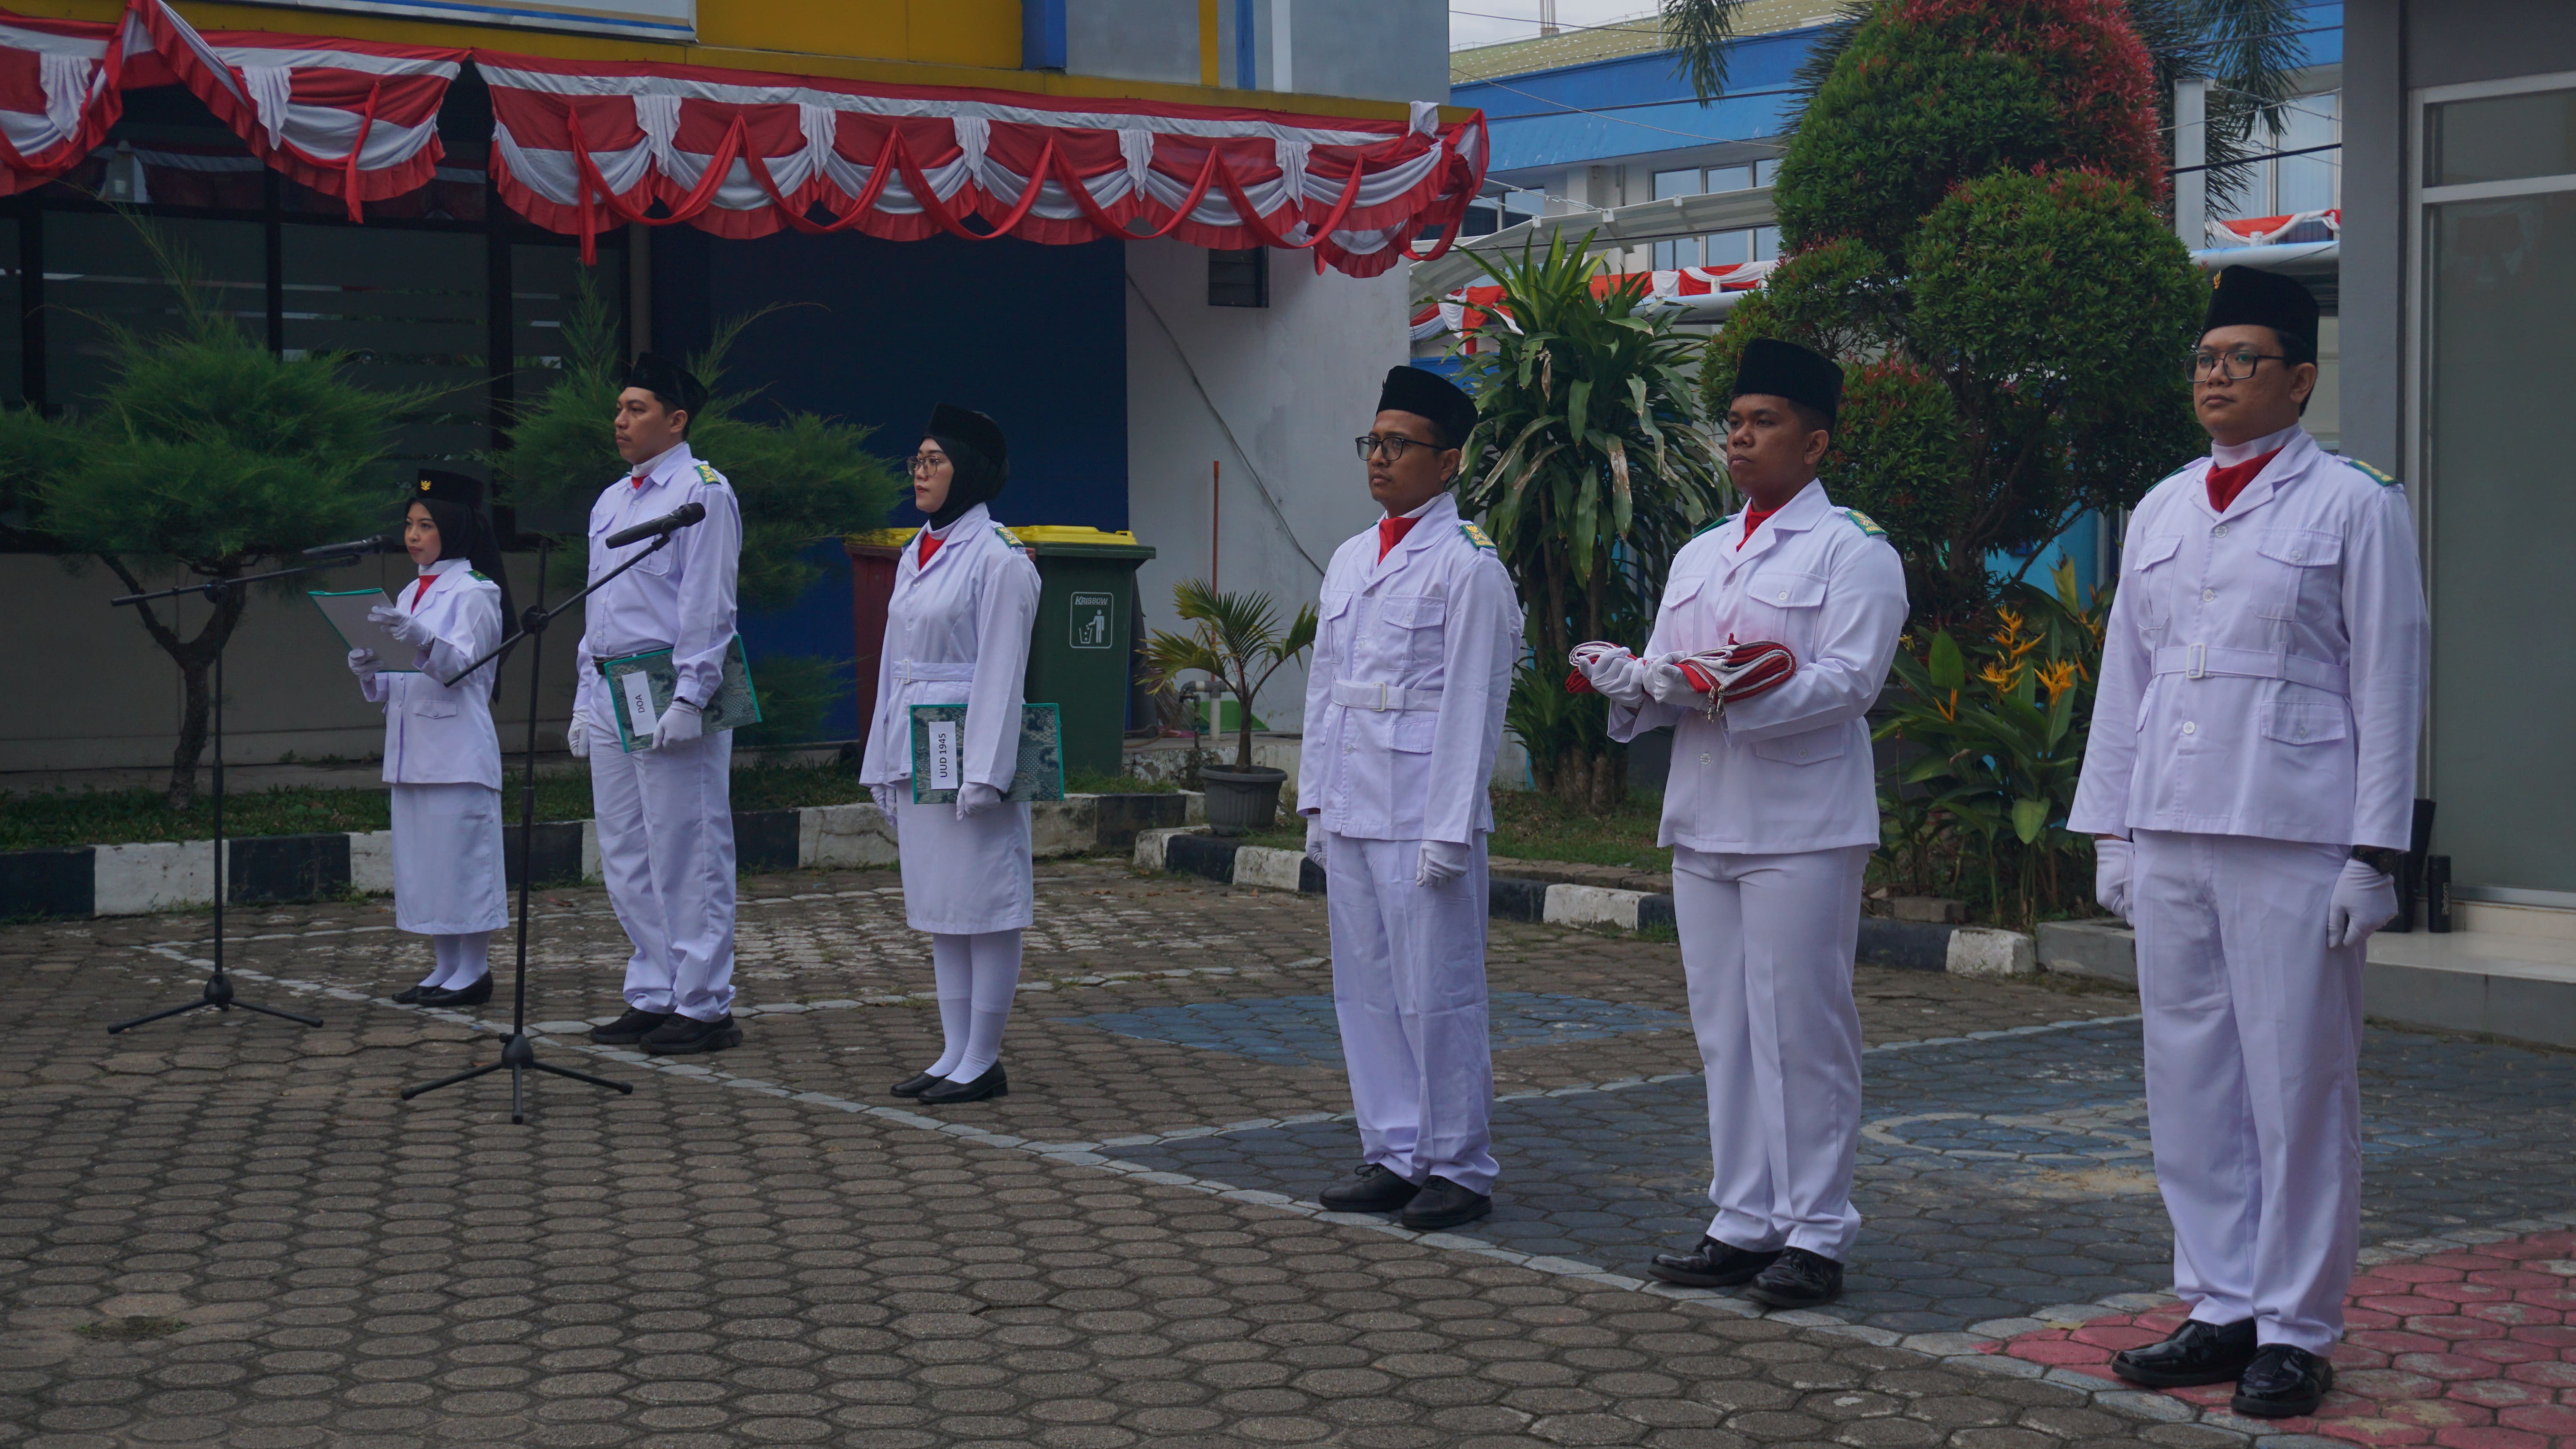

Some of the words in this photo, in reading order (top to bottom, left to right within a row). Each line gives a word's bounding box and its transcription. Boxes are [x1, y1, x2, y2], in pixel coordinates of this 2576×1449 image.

[1075, 596, 1108, 605] KRISBOW
[635, 694, 645, 713] DOA
[938, 733, 947, 755] 1945
[939, 757, 948, 778] UUD
